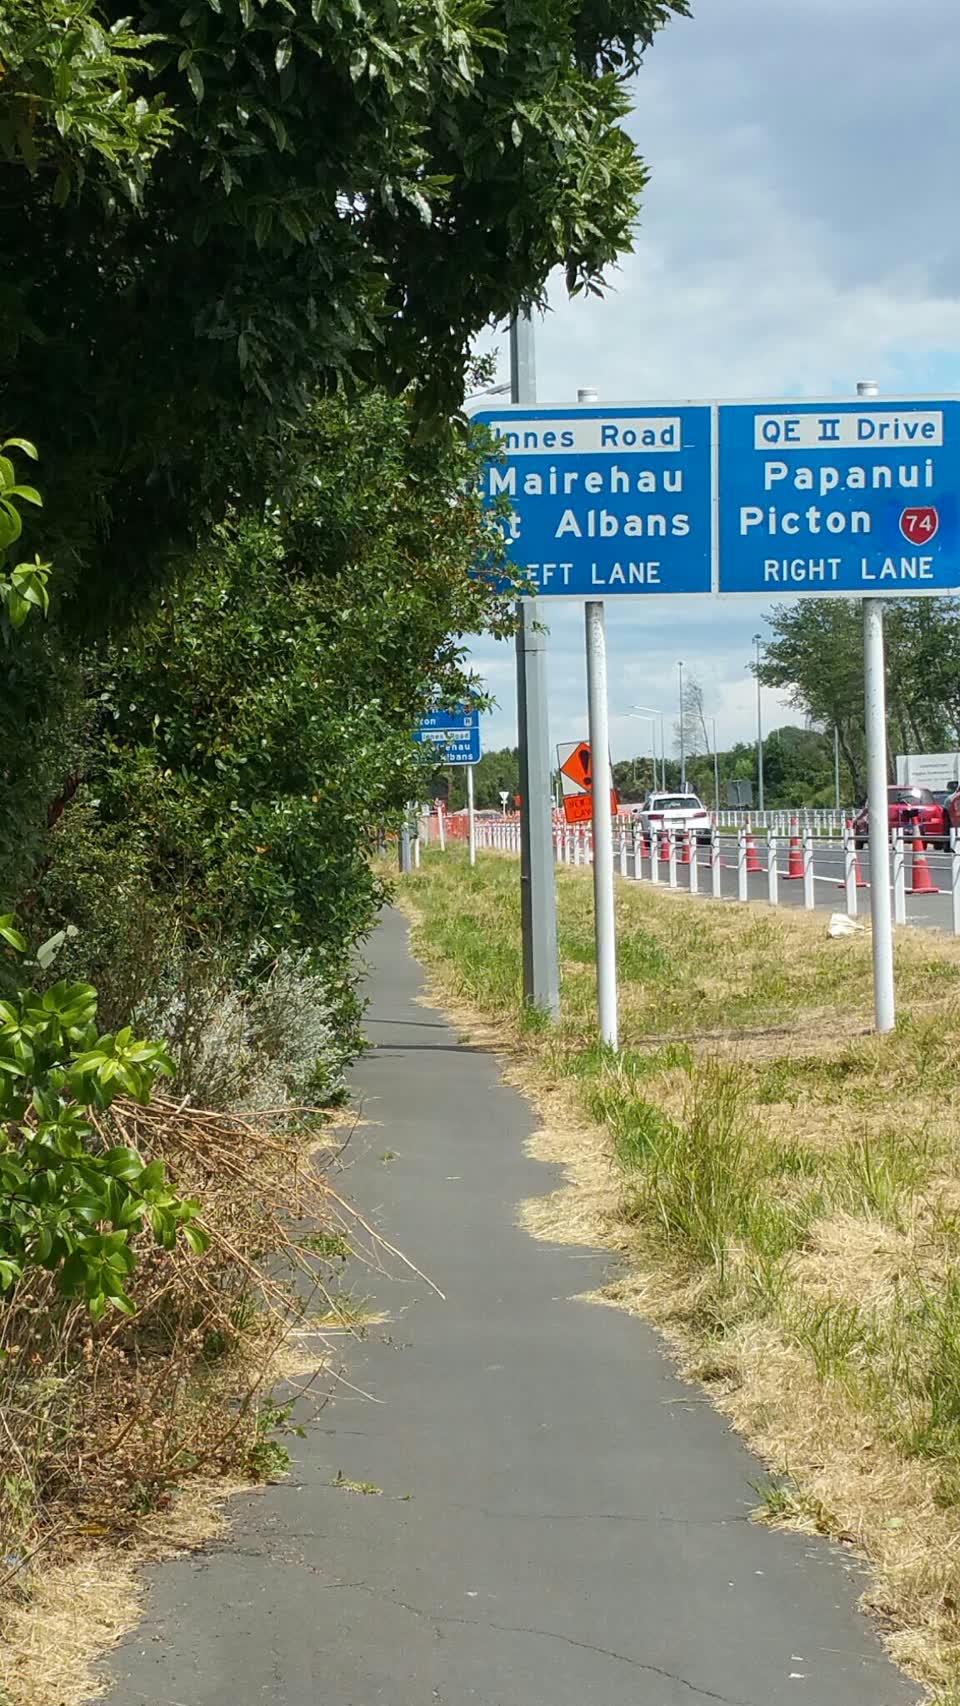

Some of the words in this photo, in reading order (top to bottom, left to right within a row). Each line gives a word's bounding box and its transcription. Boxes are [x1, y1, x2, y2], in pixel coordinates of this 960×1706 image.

[601, 424, 675, 447] Road
[762, 420, 801, 444] QE
[818, 419, 840, 441] II
[857, 418, 936, 440] Drive
[489, 465, 683, 496] Mairehau
[764, 458, 933, 497] Papanui
[555, 509, 690, 538] Albans
[739, 505, 871, 536] Picton
[905, 514, 933, 533] 74
[514, 563, 574, 585] EFT
[591, 562, 661, 585] LANE
[764, 558, 842, 582] RIGHT
[861, 556, 934, 580] LANE
[447, 753, 474, 761] bans
